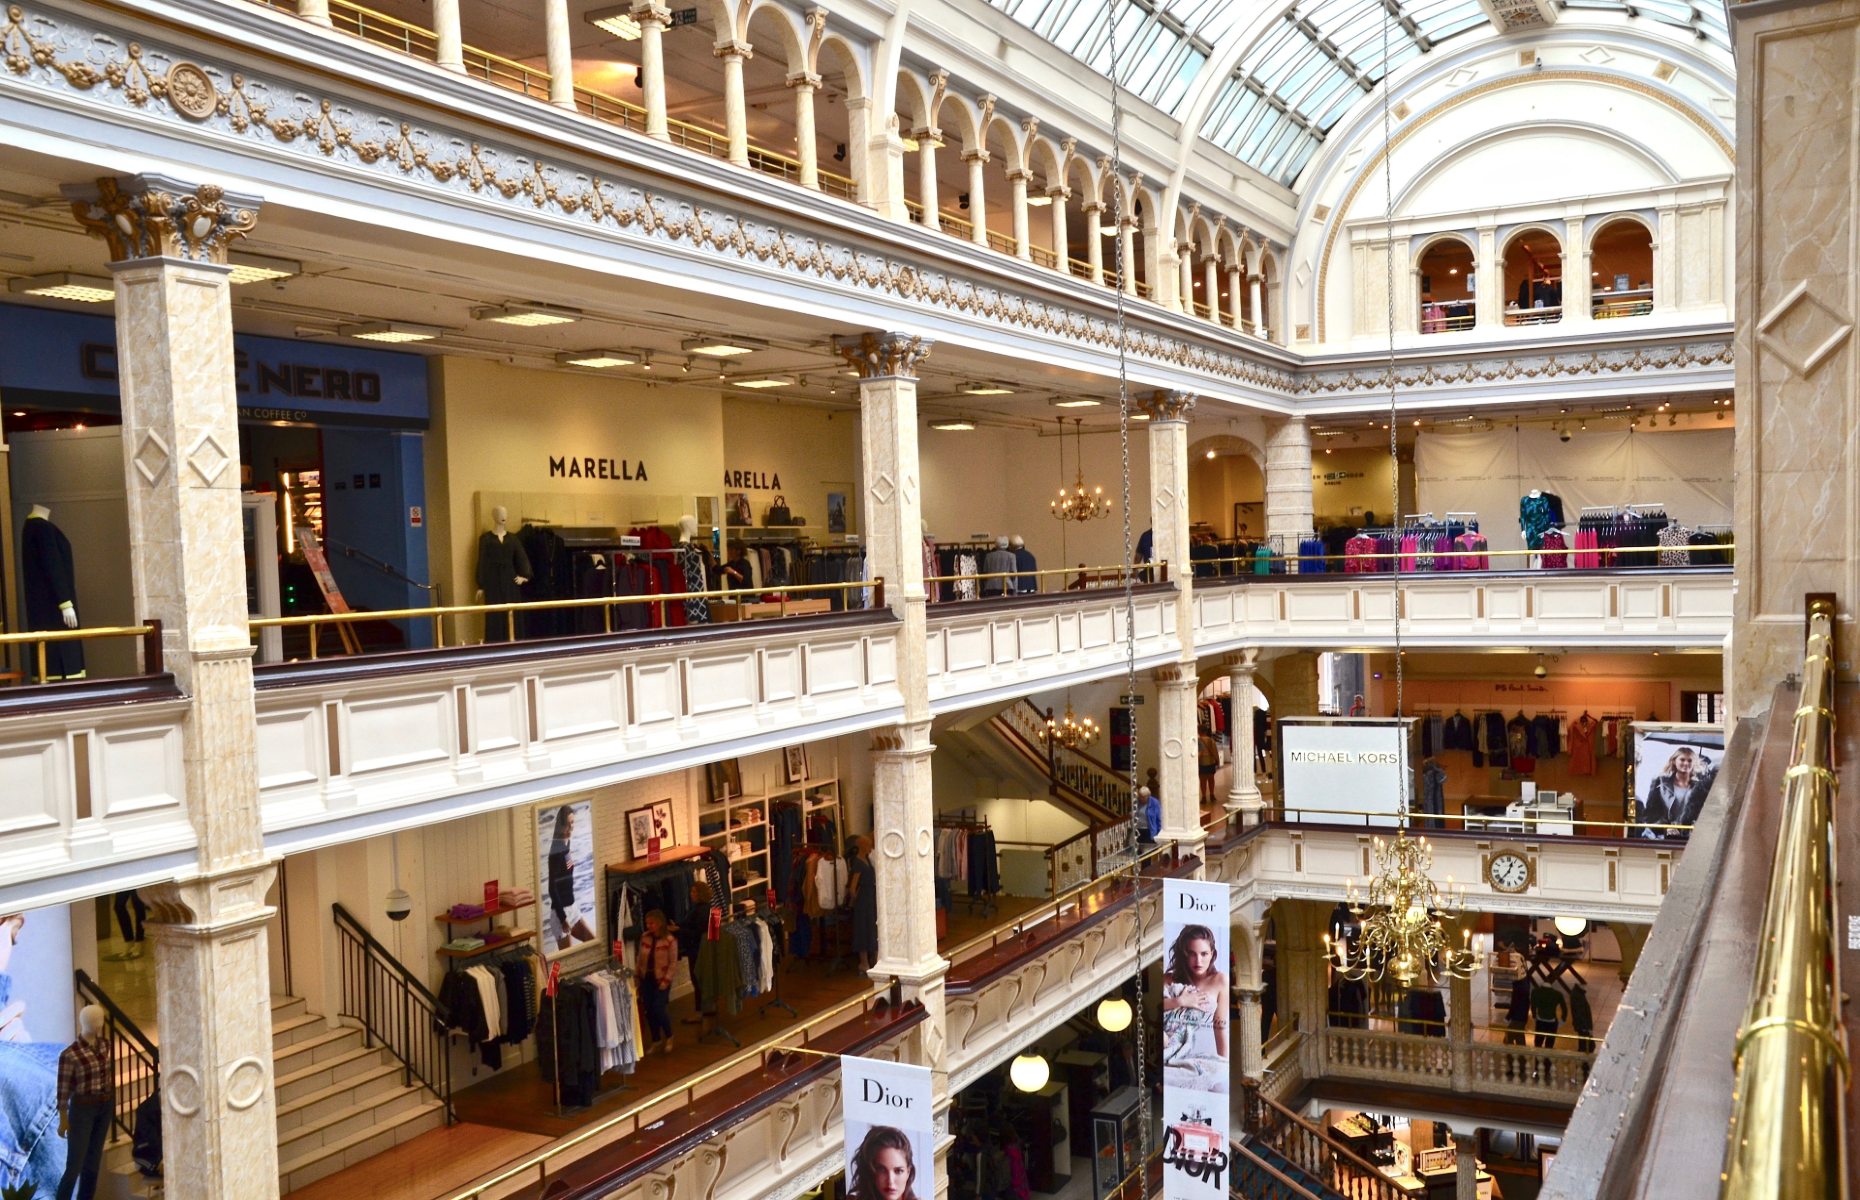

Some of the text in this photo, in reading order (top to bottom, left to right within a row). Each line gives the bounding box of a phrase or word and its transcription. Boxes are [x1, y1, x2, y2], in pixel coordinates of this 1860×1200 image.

[257, 361, 381, 402] NERO
[254, 408, 291, 420] COFFEE
[549, 456, 648, 482] MARELLA
[724, 469, 781, 491] ARELLA
[1291, 751, 1398, 764] MICHAEL KORS
[1179, 893, 1217, 911] Dior
[861, 1078, 914, 1109] Dior
